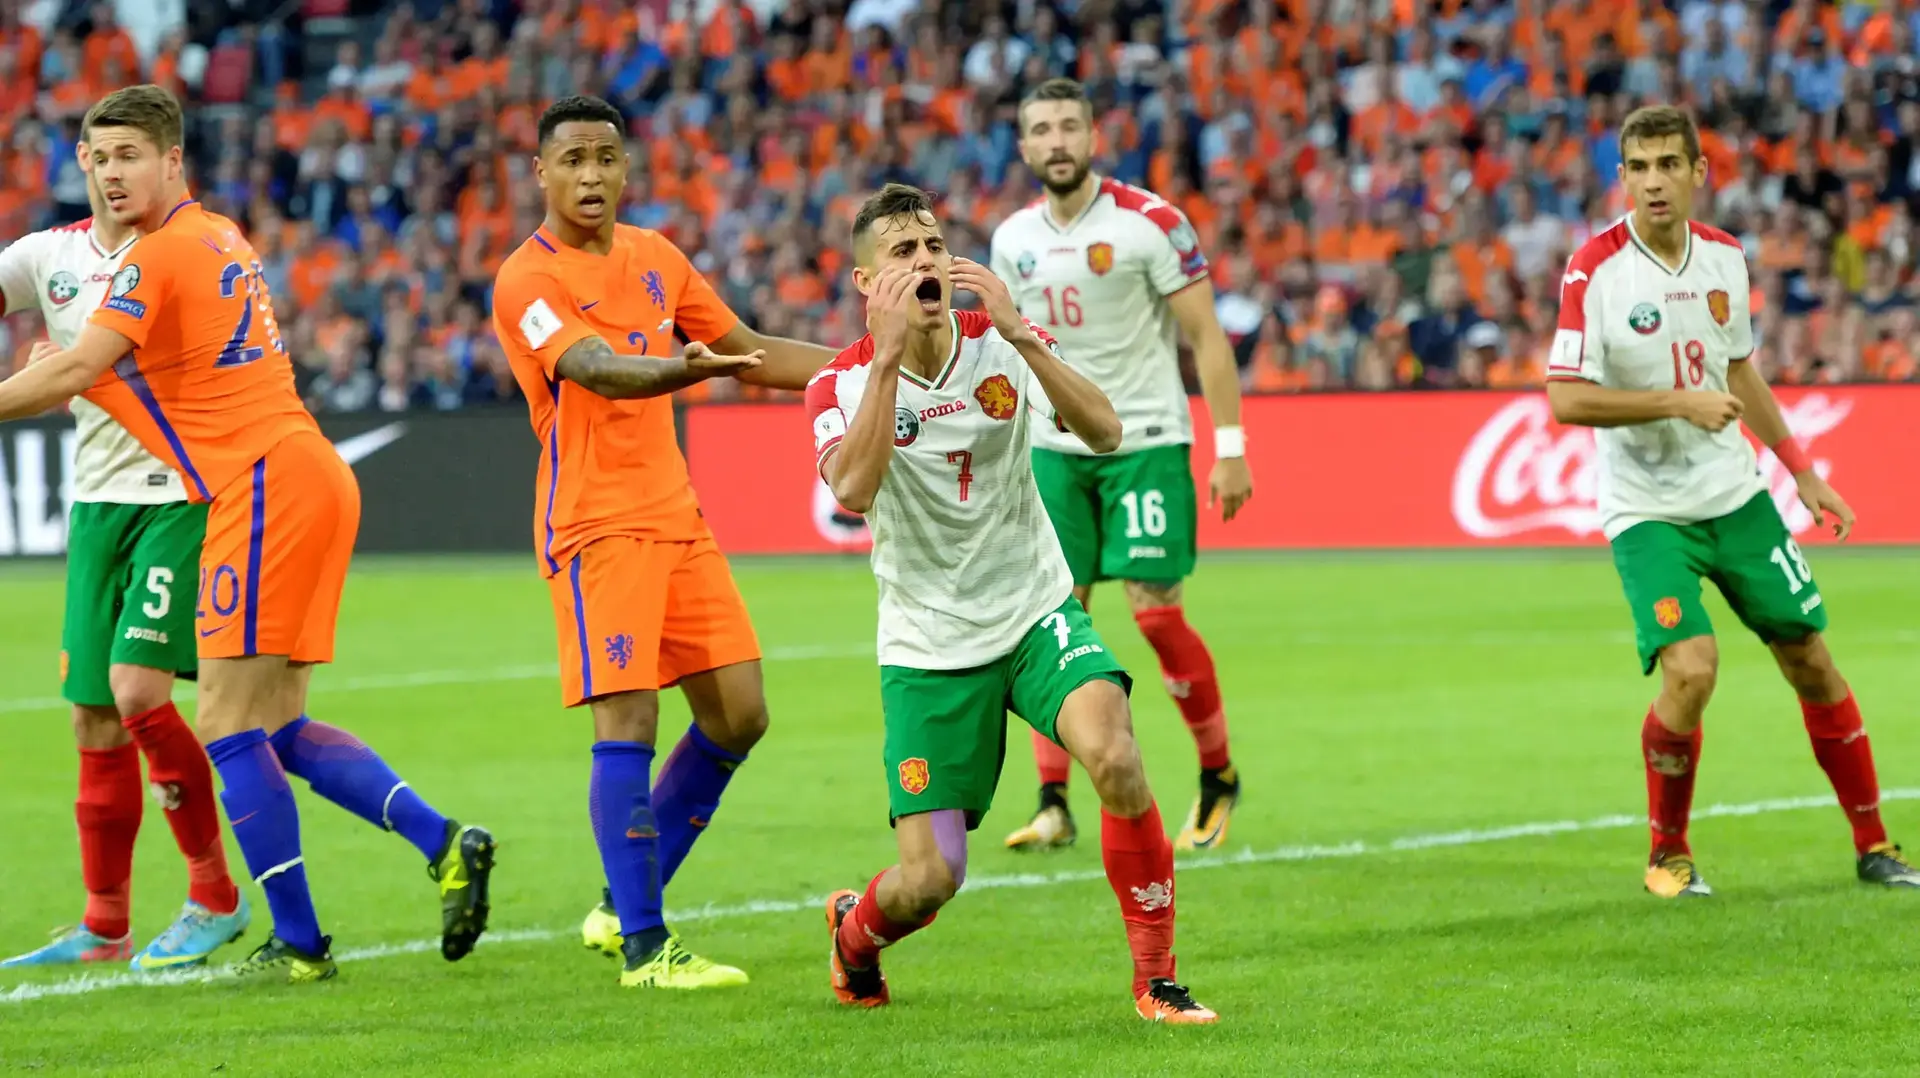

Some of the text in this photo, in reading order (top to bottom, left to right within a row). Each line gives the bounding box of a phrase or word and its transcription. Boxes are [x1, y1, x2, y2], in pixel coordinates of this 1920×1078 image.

[1043, 286, 1084, 328] 16
[1671, 339, 1705, 391] 18
[946, 450, 974, 502] 7
[1120, 489, 1167, 538] 16
[1770, 537, 1811, 595] 18
[142, 566, 174, 619] 5
[1040, 612, 1071, 651] 7
